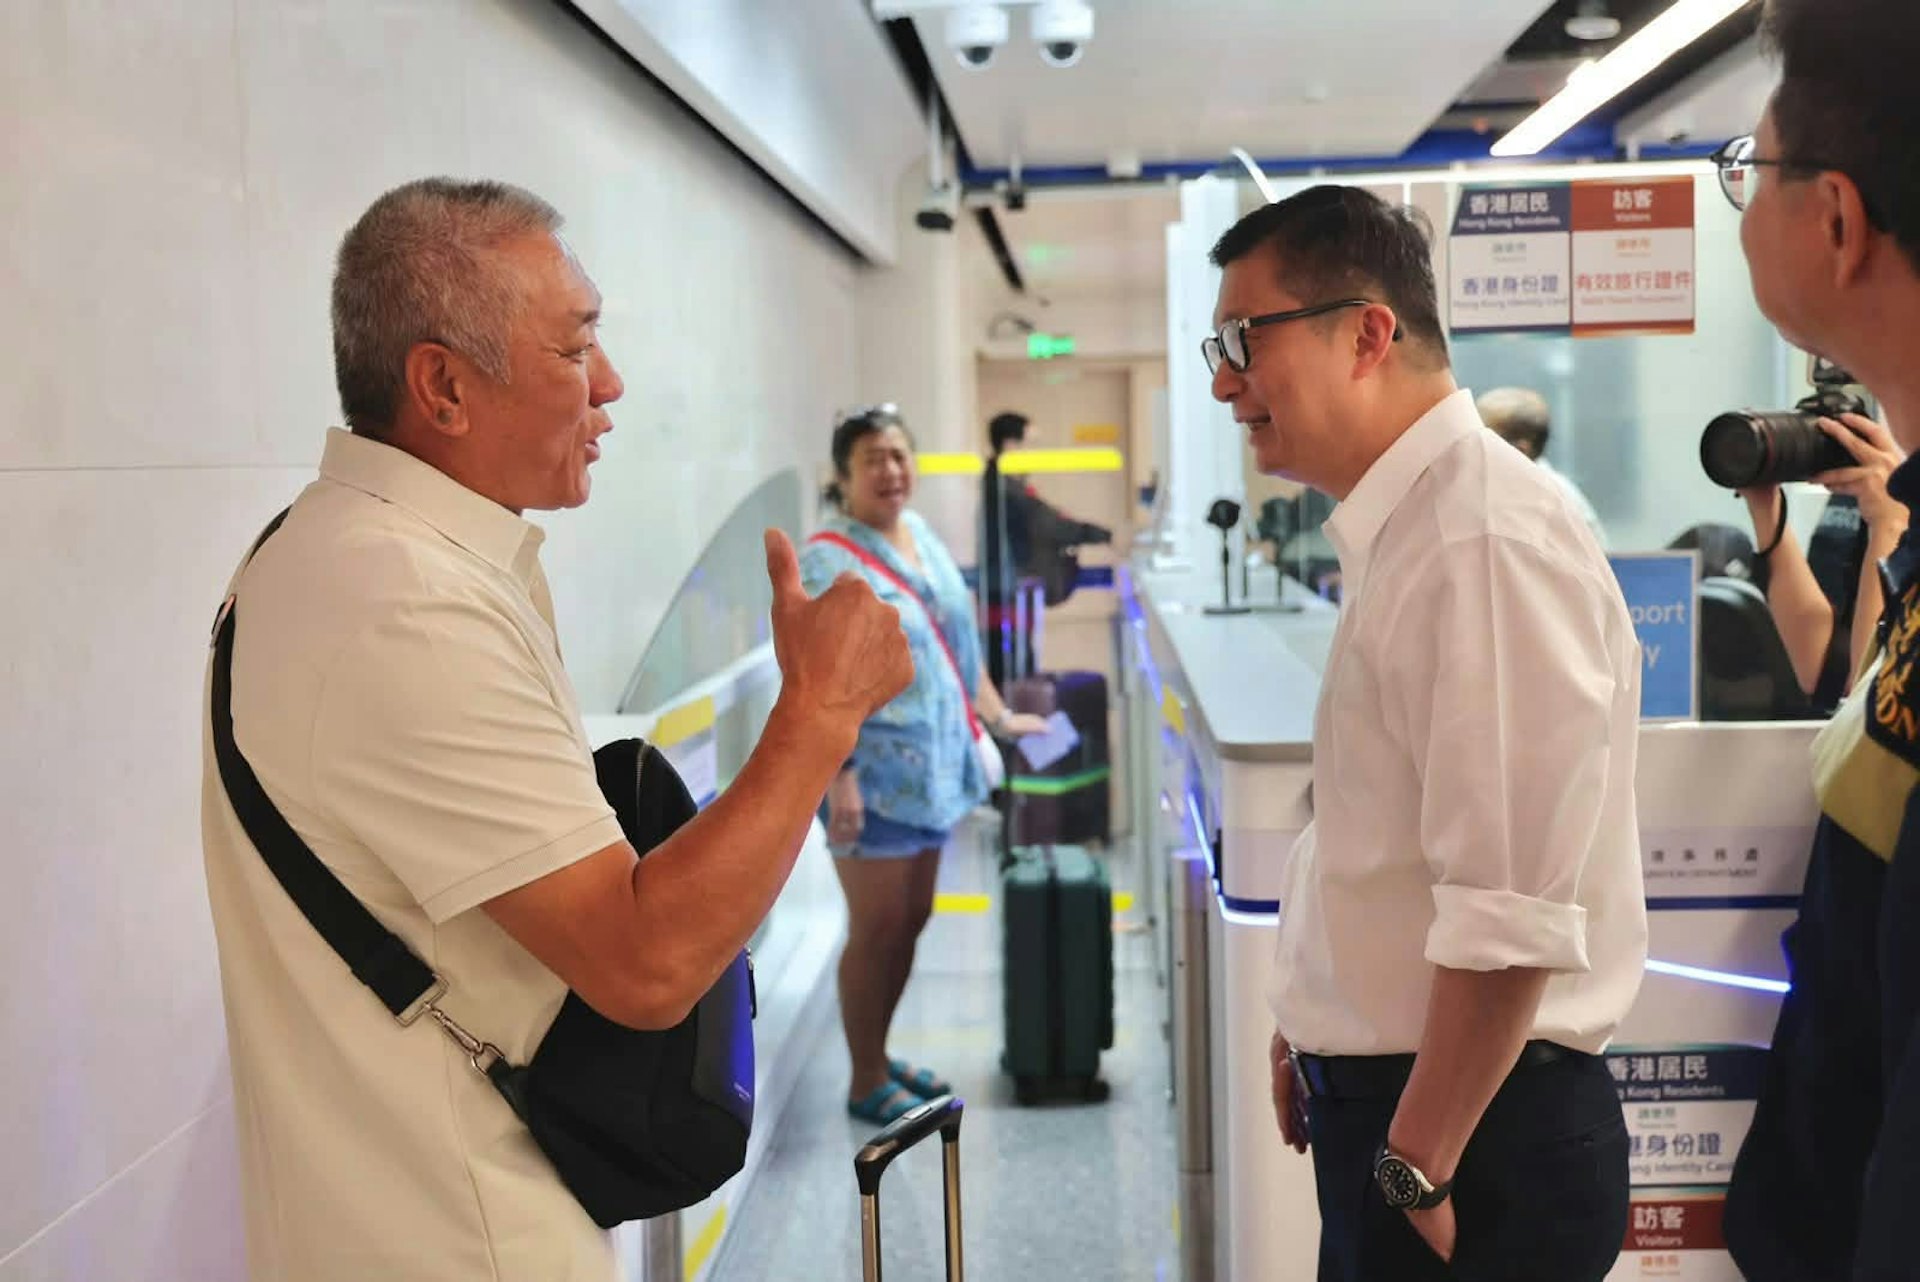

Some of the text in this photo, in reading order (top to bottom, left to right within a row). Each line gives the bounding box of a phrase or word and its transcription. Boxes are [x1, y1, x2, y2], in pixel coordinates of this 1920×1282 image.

[1470, 192, 1549, 215] 香港居民
[1613, 189, 1652, 210] 訪客
[1462, 275, 1558, 295] 香港身份證
[1577, 271, 1690, 291] 有效旅行證件
[1605, 1055, 1708, 1081] 香港居民
[1626, 1086, 1661, 1100] Kong
[1663, 1084, 1725, 1097] Residents
[1634, 1206, 1684, 1230] 訪客
[1635, 1234, 1684, 1247] Visitors
